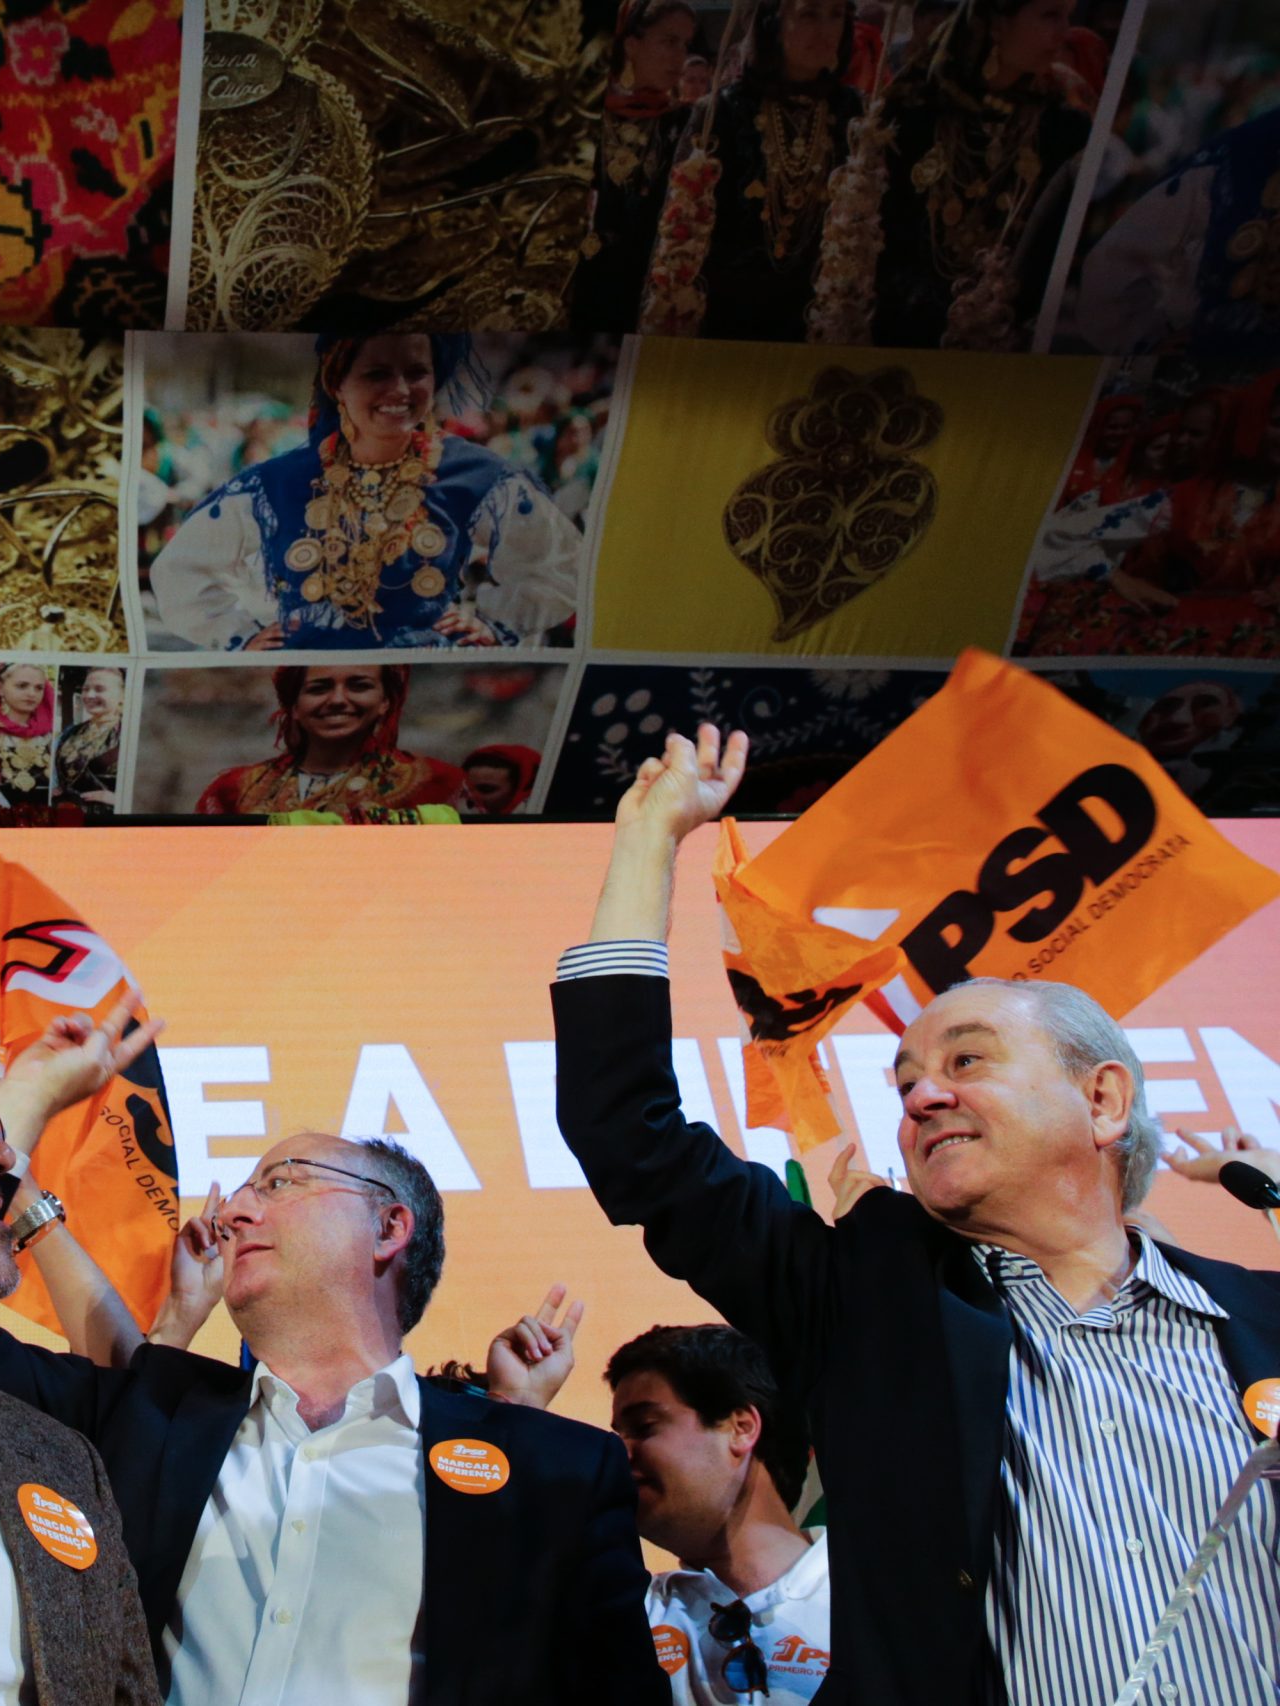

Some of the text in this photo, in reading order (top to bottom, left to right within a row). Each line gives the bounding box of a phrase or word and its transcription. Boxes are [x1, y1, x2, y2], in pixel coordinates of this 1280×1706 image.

[900, 763, 1158, 996] PSD
[1028, 834, 1192, 974] SOCIAL DEMOCRATA
[339, 1043, 483, 1191] A
[99, 1105, 141, 1171] SOCIAL
[437, 1462, 501, 1480] DIFERENÇA
[438, 1456, 489, 1471] MARCAR
[491, 1464, 500, 1472] A
[28, 1511, 74, 1535] MARCAR
[32, 1522, 91, 1550] DIFERENÇA
[768, 1664, 814, 1675] PRIMEIRO
